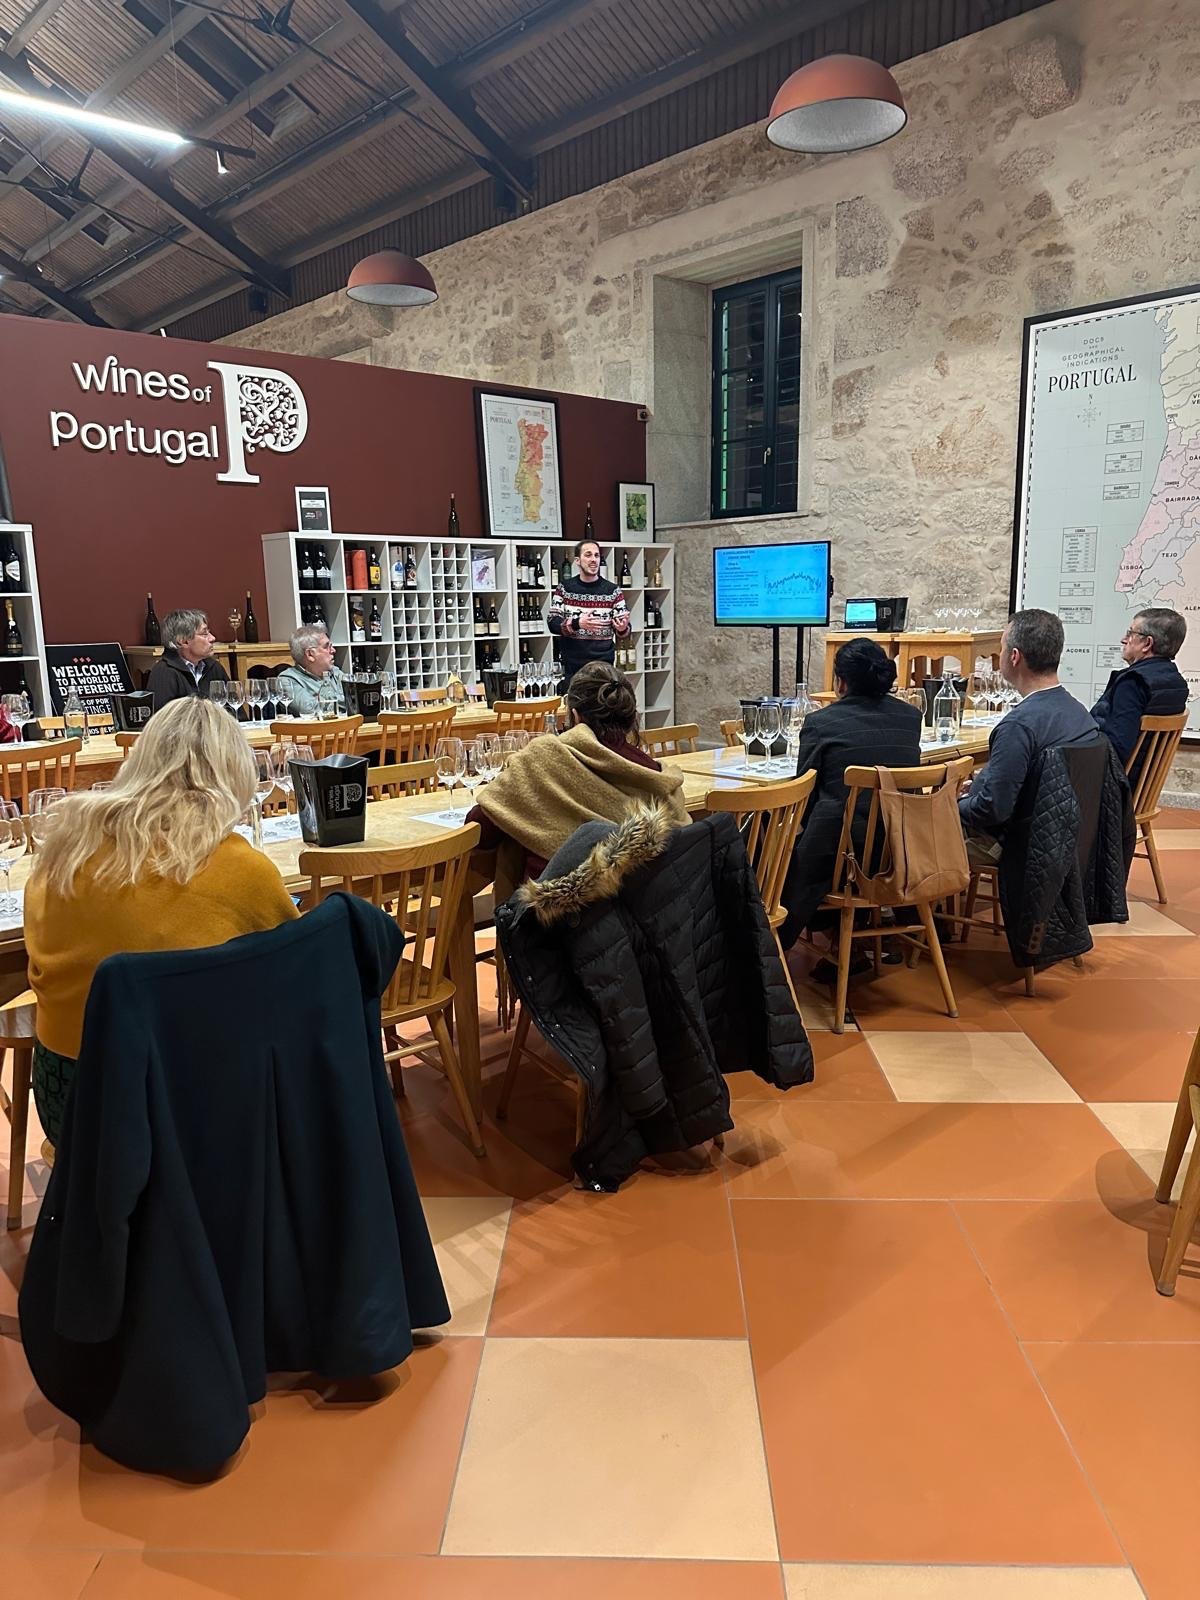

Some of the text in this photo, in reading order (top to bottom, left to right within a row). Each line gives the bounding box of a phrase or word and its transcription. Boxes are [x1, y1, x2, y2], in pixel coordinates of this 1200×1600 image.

[1062, 346, 1126, 361] GEOGRAPHICAL
[1067, 354, 1119, 368] INDICATIONS
[1048, 364, 1137, 393] PORTUGAL
[191, 385, 212, 403] of
[50, 409, 219, 464] portugal
[52, 663, 119, 678] WELCOME
[56, 674, 121, 686] TO A WORLD OF
[59, 682, 125, 696] DFERENCE
